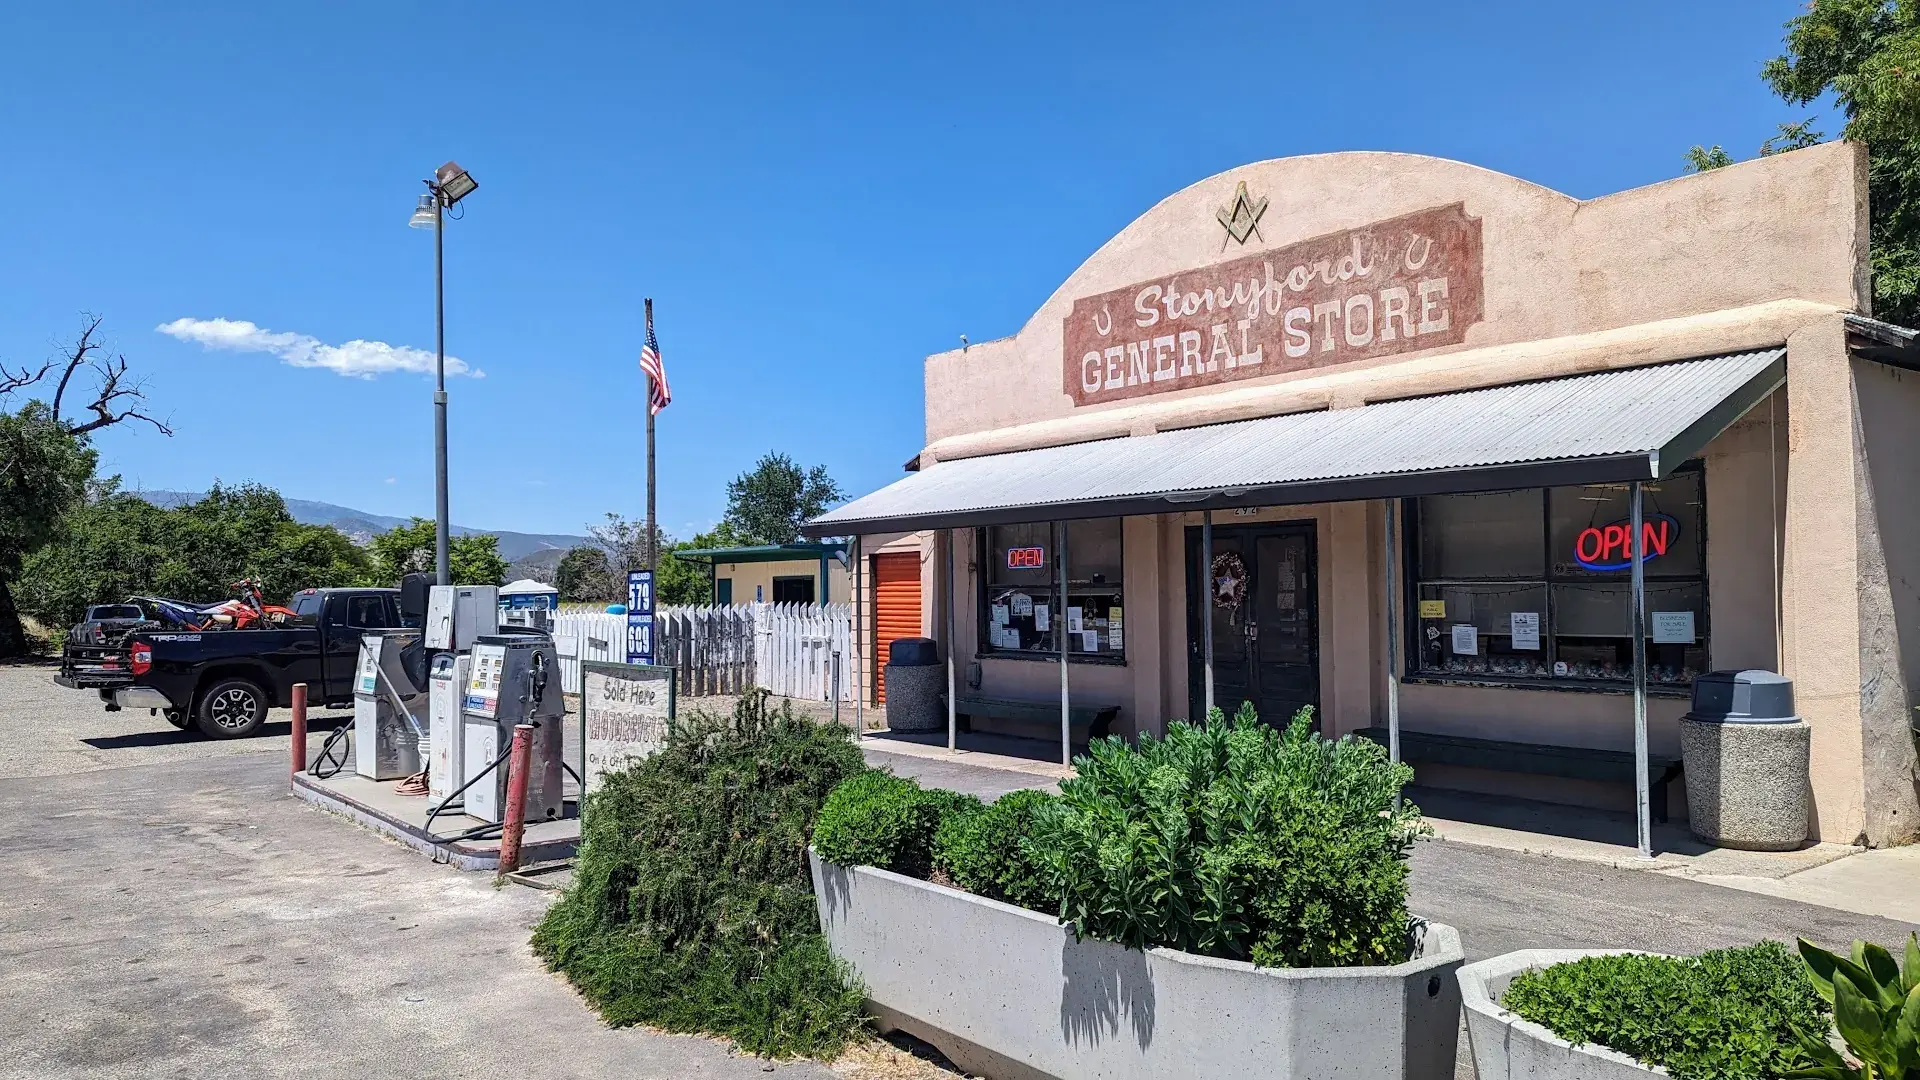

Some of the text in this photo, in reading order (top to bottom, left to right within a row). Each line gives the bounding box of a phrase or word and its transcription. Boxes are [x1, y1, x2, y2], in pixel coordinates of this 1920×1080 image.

[1135, 237, 1375, 328] Stonyford
[1082, 276, 1450, 393] GENERAL STORE
[1010, 550, 1042, 566] OPEN
[631, 572, 651, 580] UNLEADED
[628, 583, 650, 611] 579
[149, 634, 177, 642] TRD
[628, 626, 650, 654] 609
[604, 679, 656, 706] Sold Here
[589, 753, 600, 764] On
